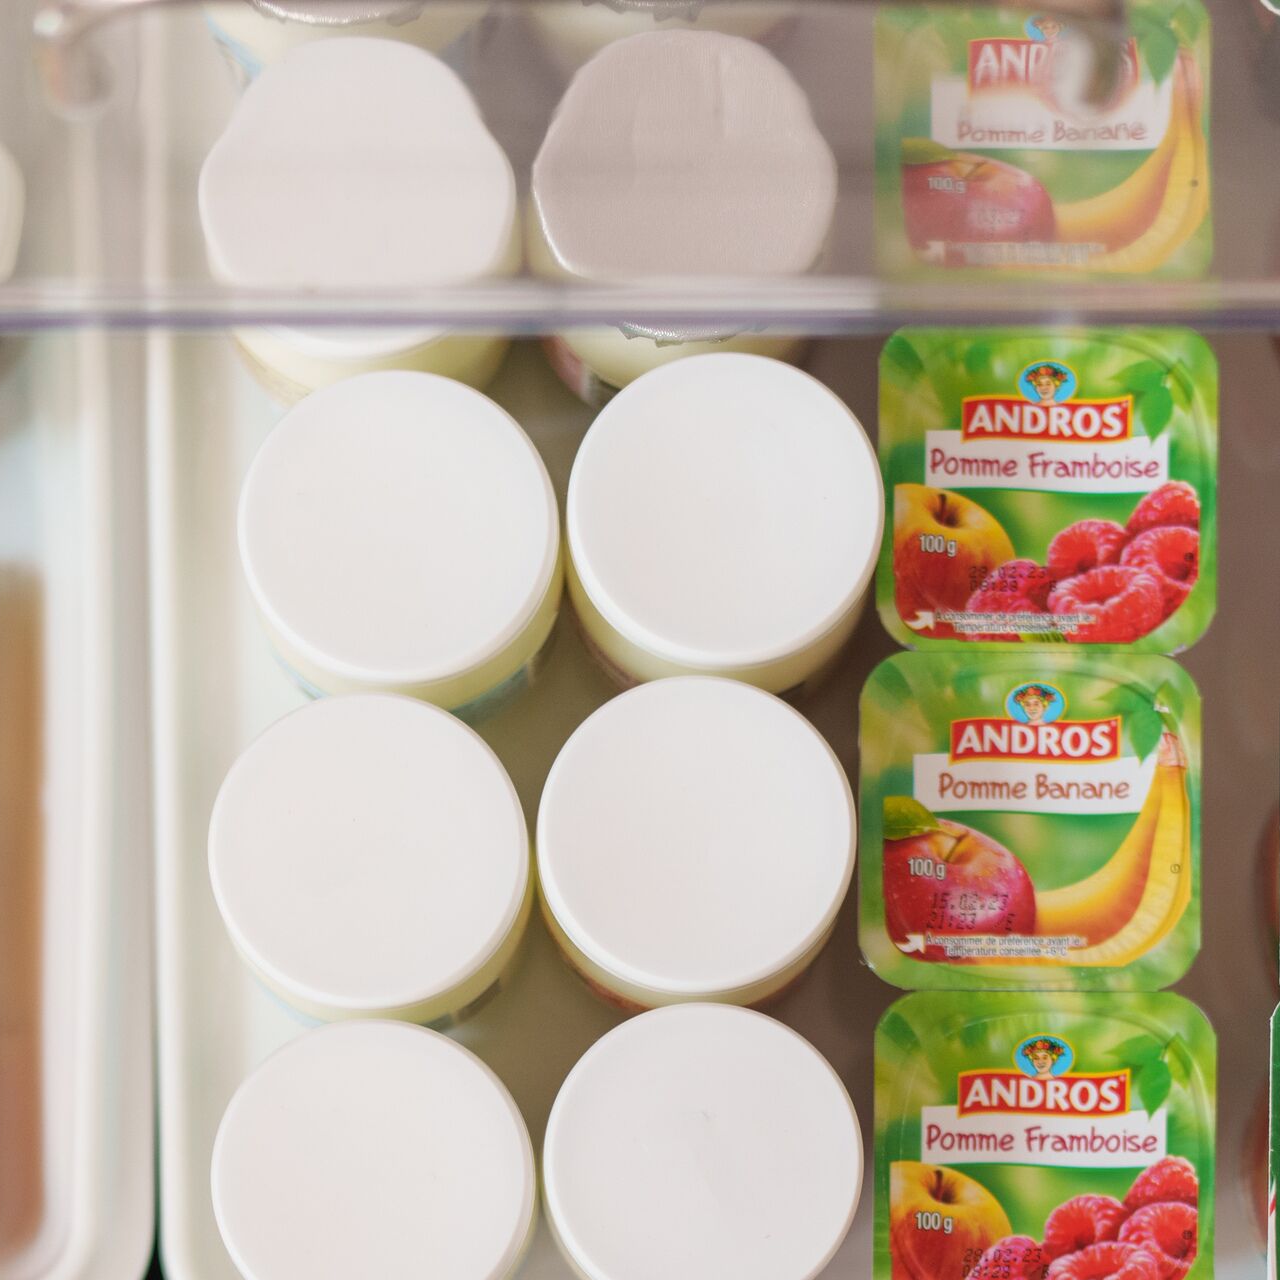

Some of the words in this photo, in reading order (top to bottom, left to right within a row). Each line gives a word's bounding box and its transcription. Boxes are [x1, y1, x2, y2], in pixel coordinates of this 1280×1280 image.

[957, 120, 1046, 143] Pomme
[1053, 120, 1149, 142] Banane
[968, 404, 1123, 438] ANDROS
[930, 449, 1018, 476] Pomme
[1028, 453, 1160, 479] Framboise
[920, 534, 944, 553] 100
[947, 540, 957, 557] g
[956, 725, 1111, 756] ANDROS
[938, 772, 1027, 800] Pomme
[1035, 773, 1130, 799] Banane
[908, 859, 933, 877] 100
[935, 864, 946, 879] g
[964, 1078, 1120, 1112] ANDROS
[926, 1124, 1014, 1152] Pomme
[1024, 1126, 1158, 1153] Framboise
[916, 1212, 941, 1230] 100
[943, 1217, 953, 1234] g
